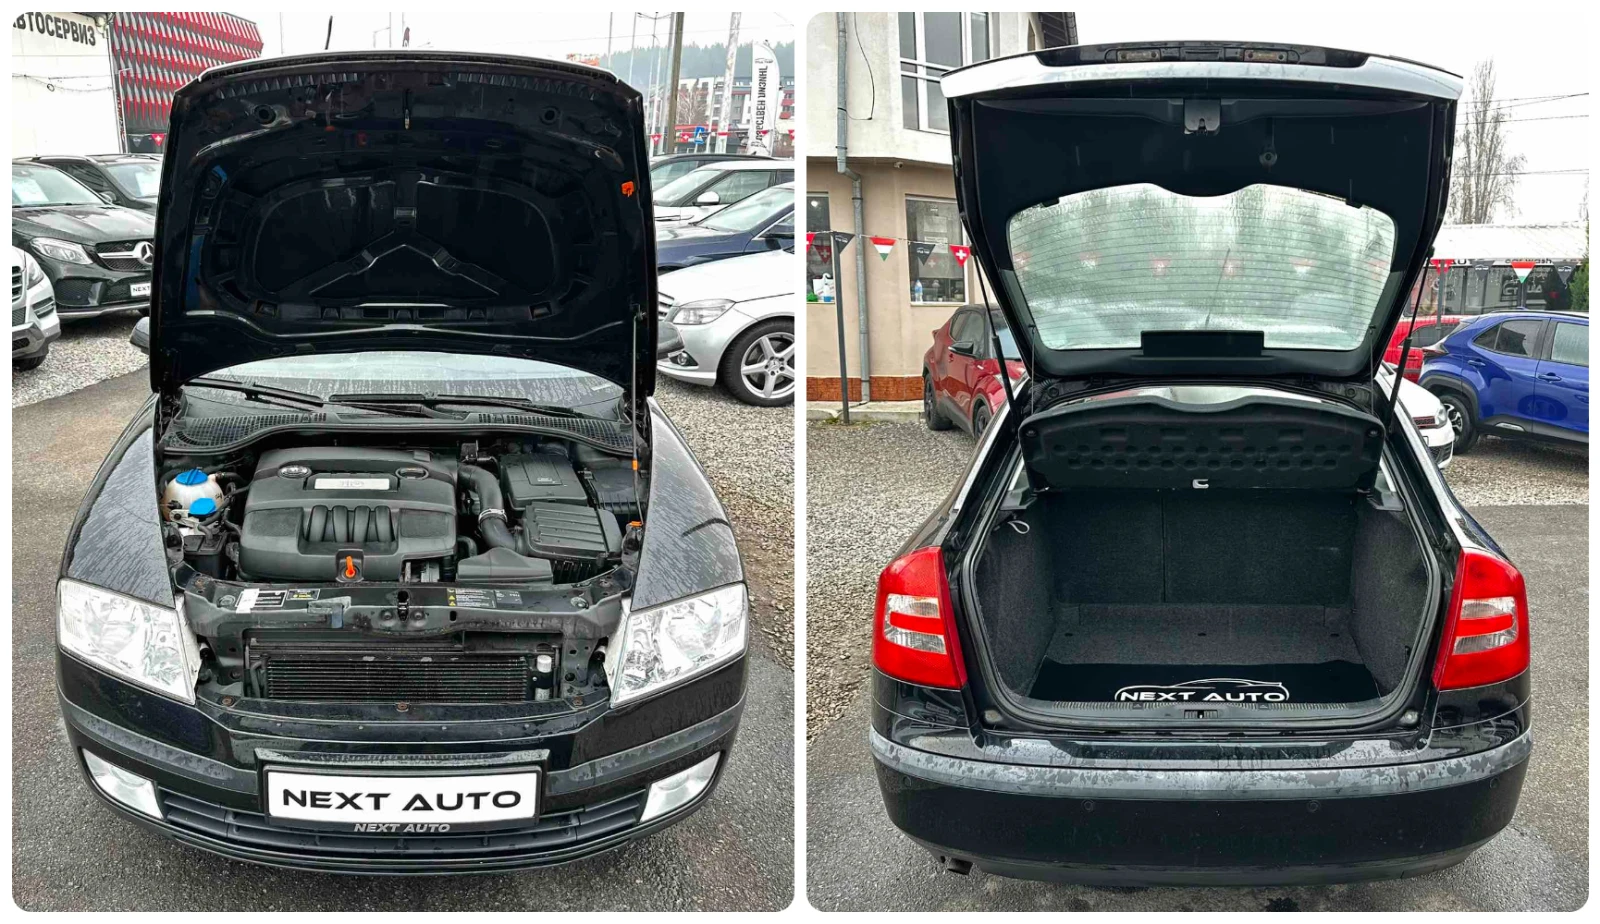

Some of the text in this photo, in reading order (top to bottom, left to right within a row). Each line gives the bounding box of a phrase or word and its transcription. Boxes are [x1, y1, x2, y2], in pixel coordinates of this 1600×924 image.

[1120, 691, 1287, 701] NEXT AUTO
[283, 788, 522, 811] NEXT AUTO
[353, 822, 451, 833] NEXT AUTO
